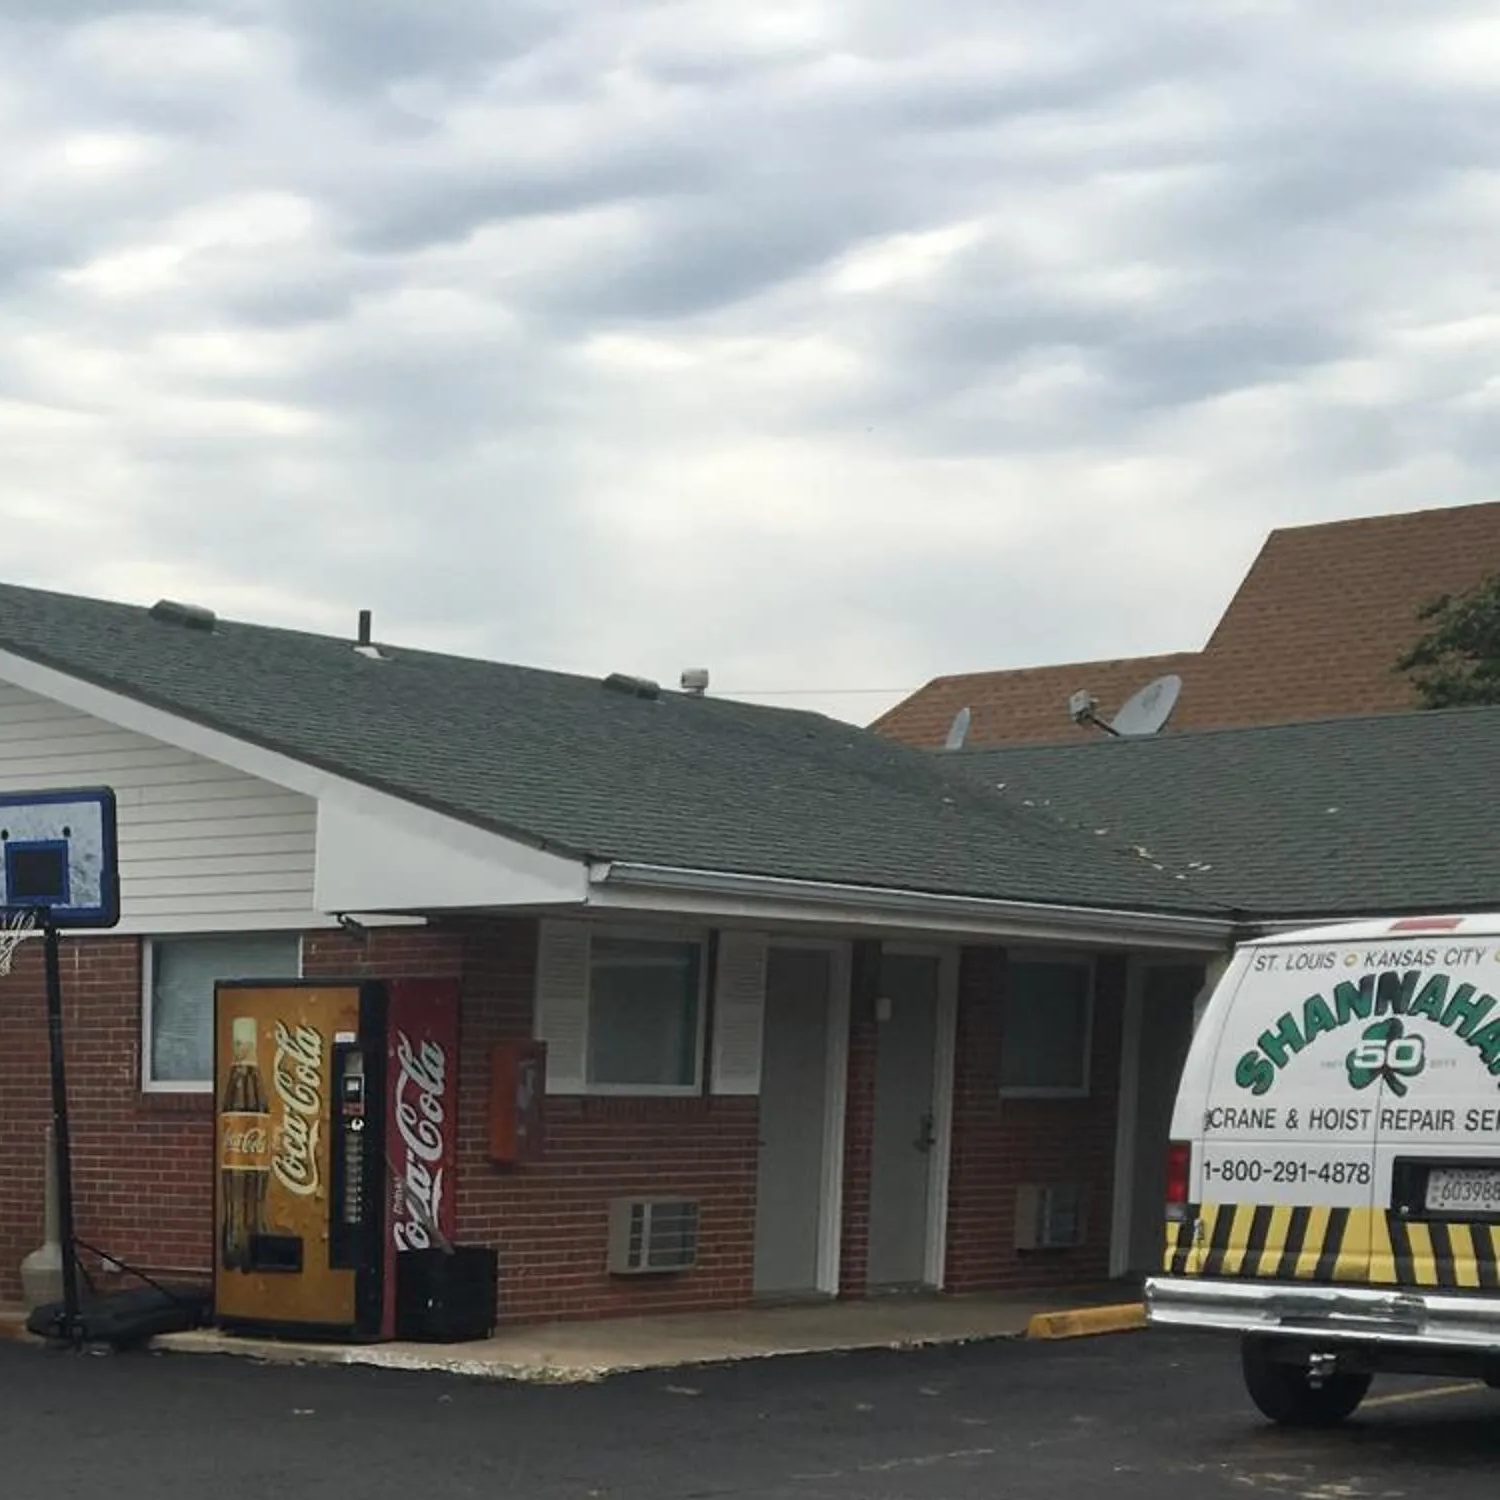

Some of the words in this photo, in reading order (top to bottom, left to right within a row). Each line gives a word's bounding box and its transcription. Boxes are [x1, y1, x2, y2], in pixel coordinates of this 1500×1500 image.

[1255, 955, 1280, 971] ST.
[1285, 952, 1337, 970] LOUIS
[1363, 949, 1437, 968] KANSAS
[1443, 947, 1487, 966] CITY
[1235, 970, 1500, 1096] SHANNAHA
[1354, 1039, 1424, 1070] 50
[1210, 1107, 1277, 1130] CRANE
[1285, 1108, 1300, 1130] &
[1310, 1109, 1372, 1131] HOIST
[1379, 1109, 1456, 1132] REPAIR
[1203, 1160, 1372, 1185] 1-800-291-4878
